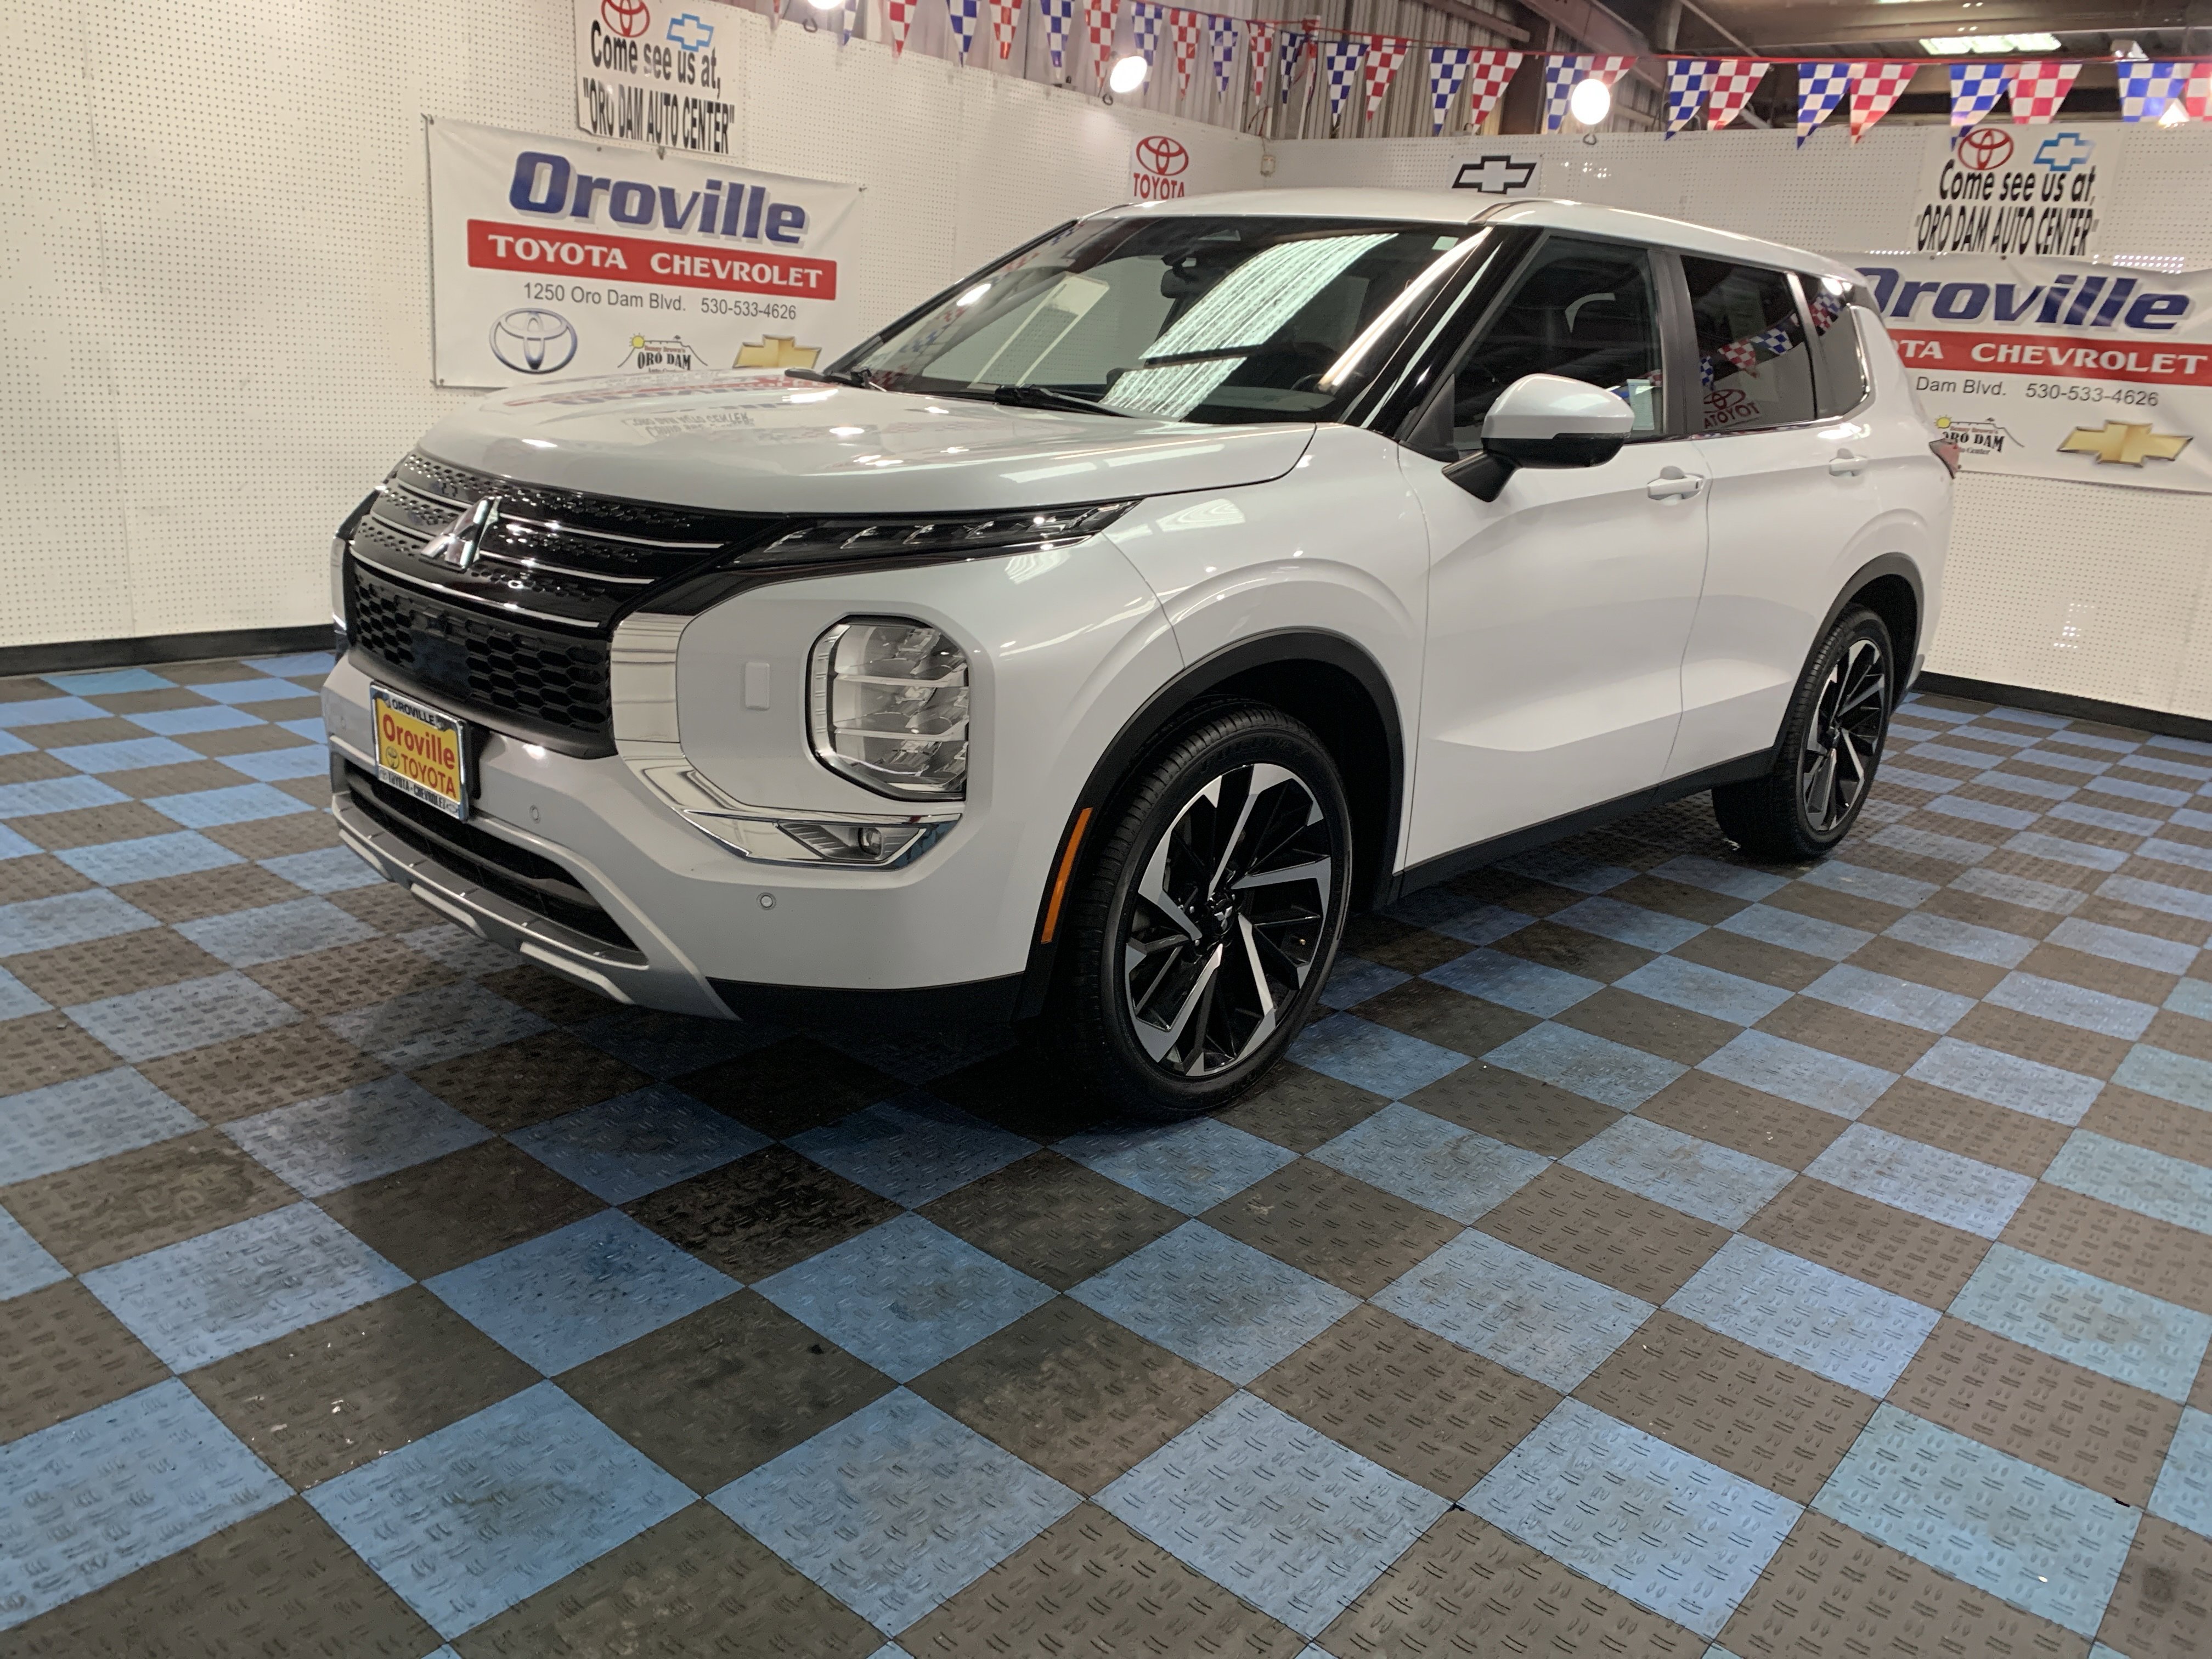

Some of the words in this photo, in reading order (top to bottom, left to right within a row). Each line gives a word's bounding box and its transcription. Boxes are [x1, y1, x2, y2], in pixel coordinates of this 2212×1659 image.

[591, 20, 638, 74] Come
[644, 43, 672, 81] see
[678, 50, 696, 85] us
[701, 47, 721, 100] at,
[618, 83, 643, 141] DAM
[646, 89, 678, 146] AUTO
[508, 150, 807, 245] Oroville
[1133, 172, 1185, 200] TOYOTA
[1939, 159, 1995, 200] Come
[1999, 171, 2036, 201] see
[2041, 171, 2067, 202] us
[1951, 205, 1992, 252] DAM
[1990, 206, 2035, 255] AUTO
[487, 233, 628, 270] TOYOTA
[650, 252, 823, 289] CHEVROLET
[523, 282, 565, 302] 1250
[570, 285, 602, 305] Oro
[607, 289, 644, 308] Dam
[648, 292, 686, 312] Blvd.
[701, 297, 797, 320] 530-533-4626
[637, 351, 663, 370] ORO
[666, 353, 691, 371] DAM
[1971, 342, 2209, 375] CHEVROLET
[1916, 376, 1957, 393] Dam
[1962, 379, 2007, 396] Blvd.
[2025, 382, 2159, 407] 530-533-4626
[1974, 433, 2005, 453] DAM
[391, 698, 436, 726] OROVILLE
[382, 713, 455, 770] Oroville
[400, 753, 456, 799] TOYOTA
